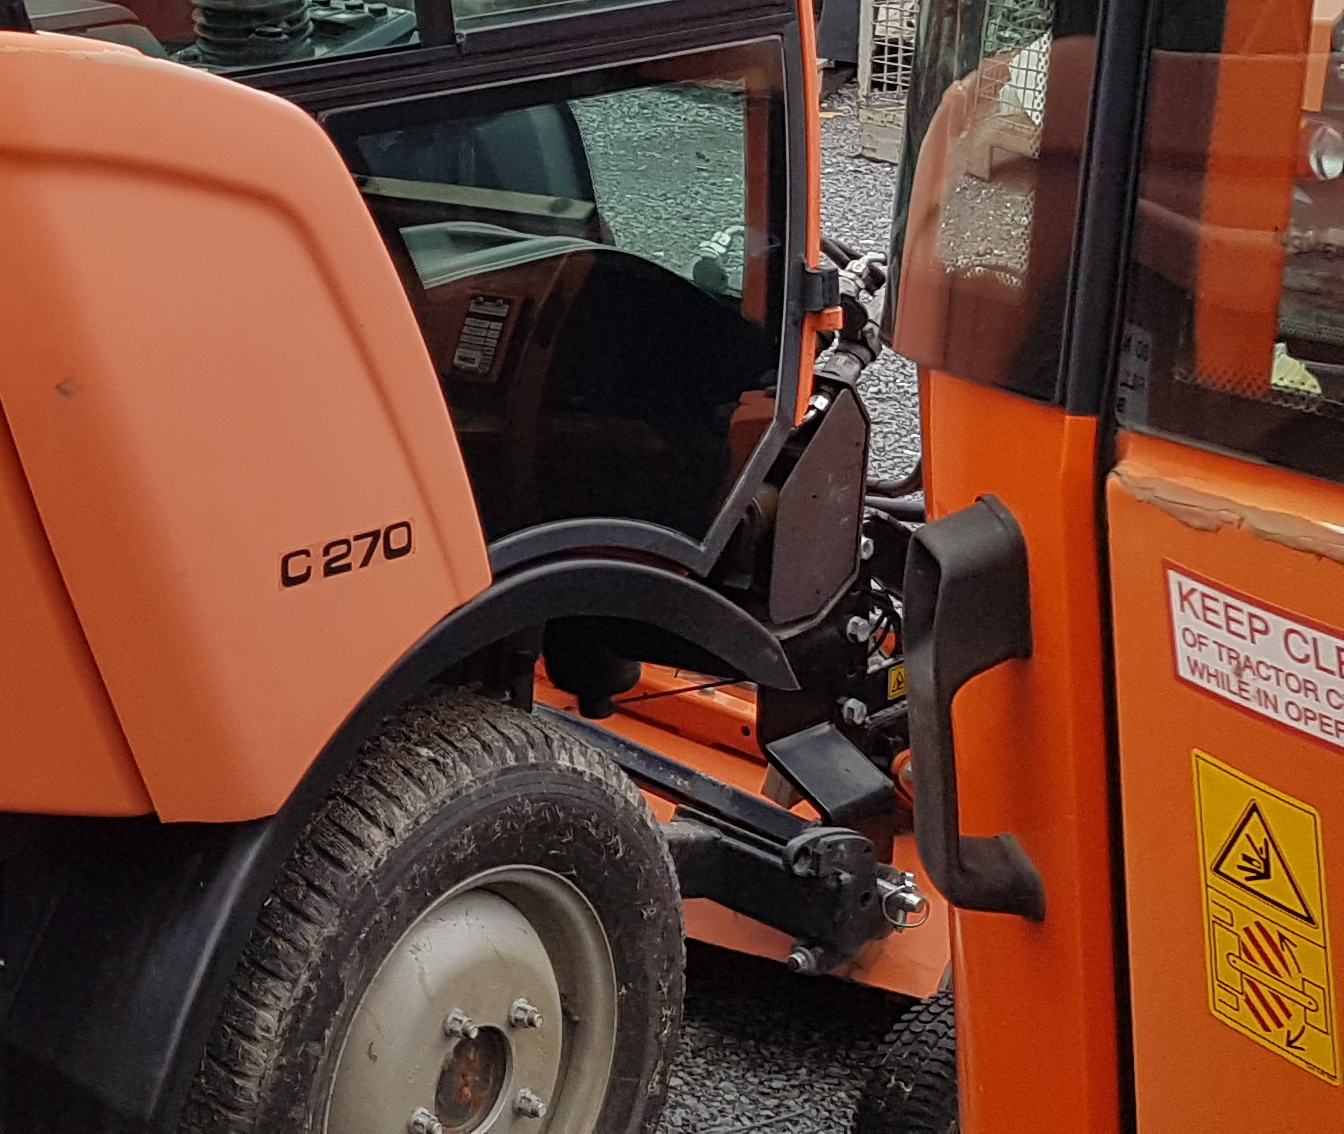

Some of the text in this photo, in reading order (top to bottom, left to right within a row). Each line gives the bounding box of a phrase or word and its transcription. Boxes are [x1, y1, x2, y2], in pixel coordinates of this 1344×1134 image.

[280, 520, 412, 588] C 270
[1177, 580, 1271, 645] KEEP
[1182, 627, 1209, 652] OF
[1212, 640, 1320, 703] TRACTOR
[1186, 656, 1252, 702] WHILE
[1256, 688, 1280, 714] IN
